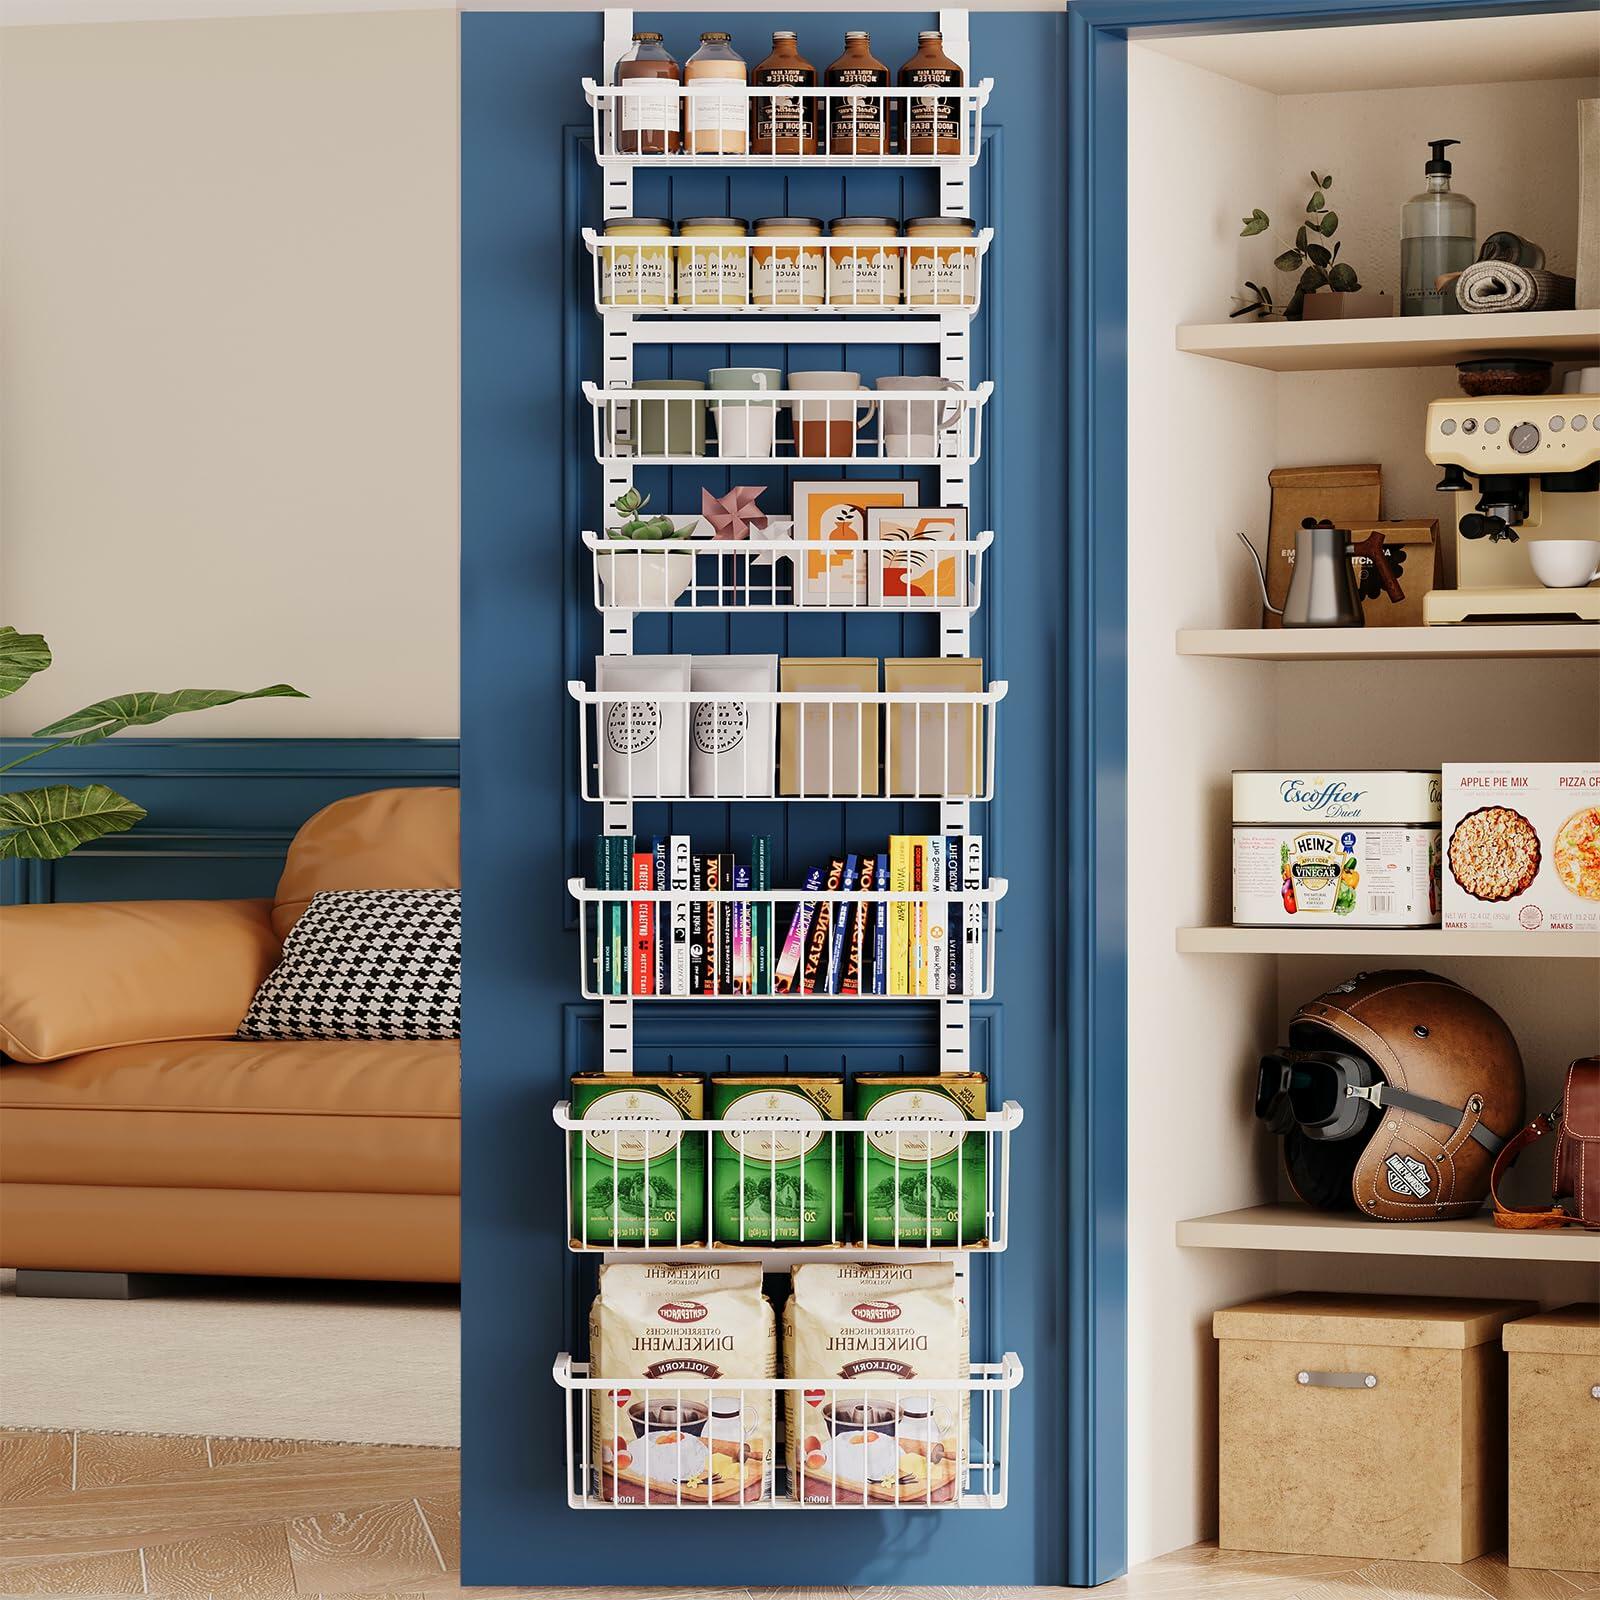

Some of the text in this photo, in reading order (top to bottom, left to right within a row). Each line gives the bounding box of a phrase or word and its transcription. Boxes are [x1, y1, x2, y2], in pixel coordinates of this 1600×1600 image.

[1460, 777, 1528, 787] APPLE PIE MIX
[1560, 777, 1586, 787] PIZZA
[1280, 780, 1368, 811] Escoffier
[1325, 804, 1361, 818] Duett
[1298, 838, 1334, 853] HEINZ
[1296, 869, 1336, 877] VINEGAR
[1389, 1157, 1428, 1196] HARLEY-DAVIDSON
[1406, 1161, 1425, 1180] MOTOR
